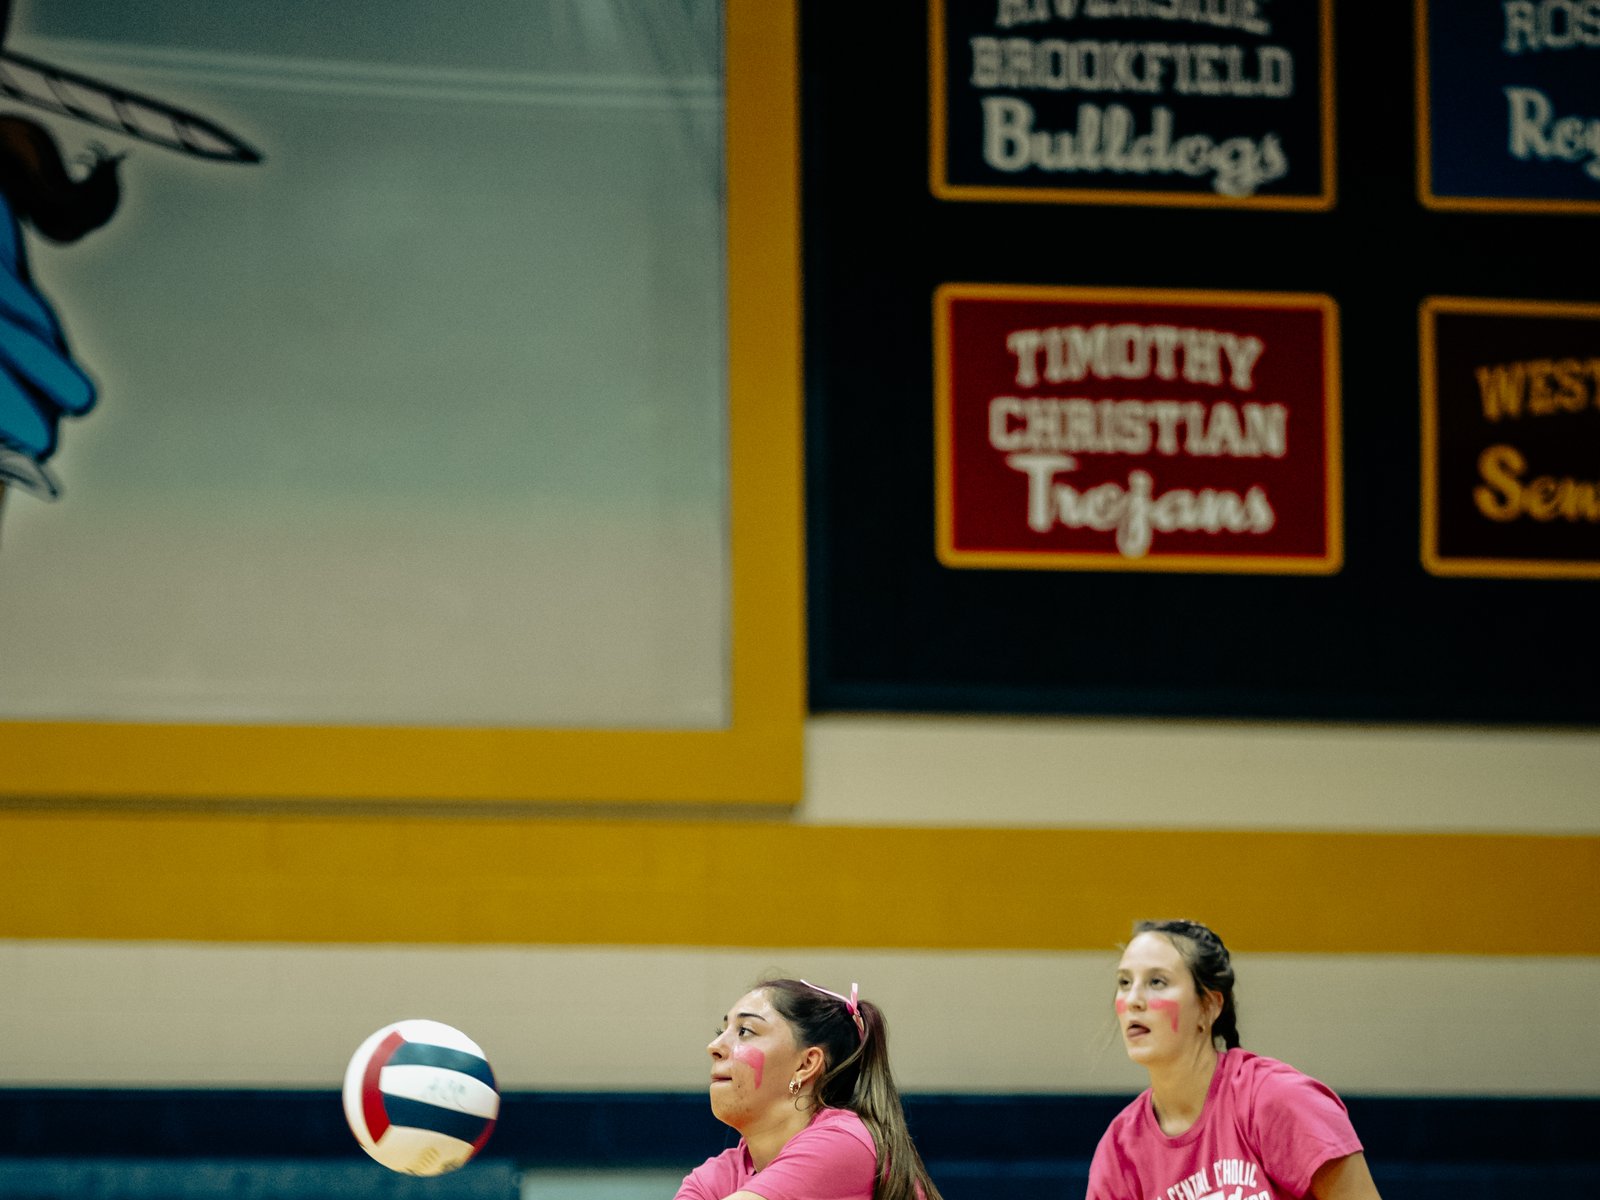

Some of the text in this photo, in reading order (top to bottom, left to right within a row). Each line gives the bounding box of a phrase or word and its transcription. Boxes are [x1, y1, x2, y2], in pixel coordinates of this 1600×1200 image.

[971, 37, 1294, 97] BROOKFIELD
[981, 97, 1288, 196] Bulldogs
[1006, 324, 1264, 390] TIMOTHY
[988, 396, 1288, 458] CHRISTIAN
[1005, 453, 1275, 558] Trojans
